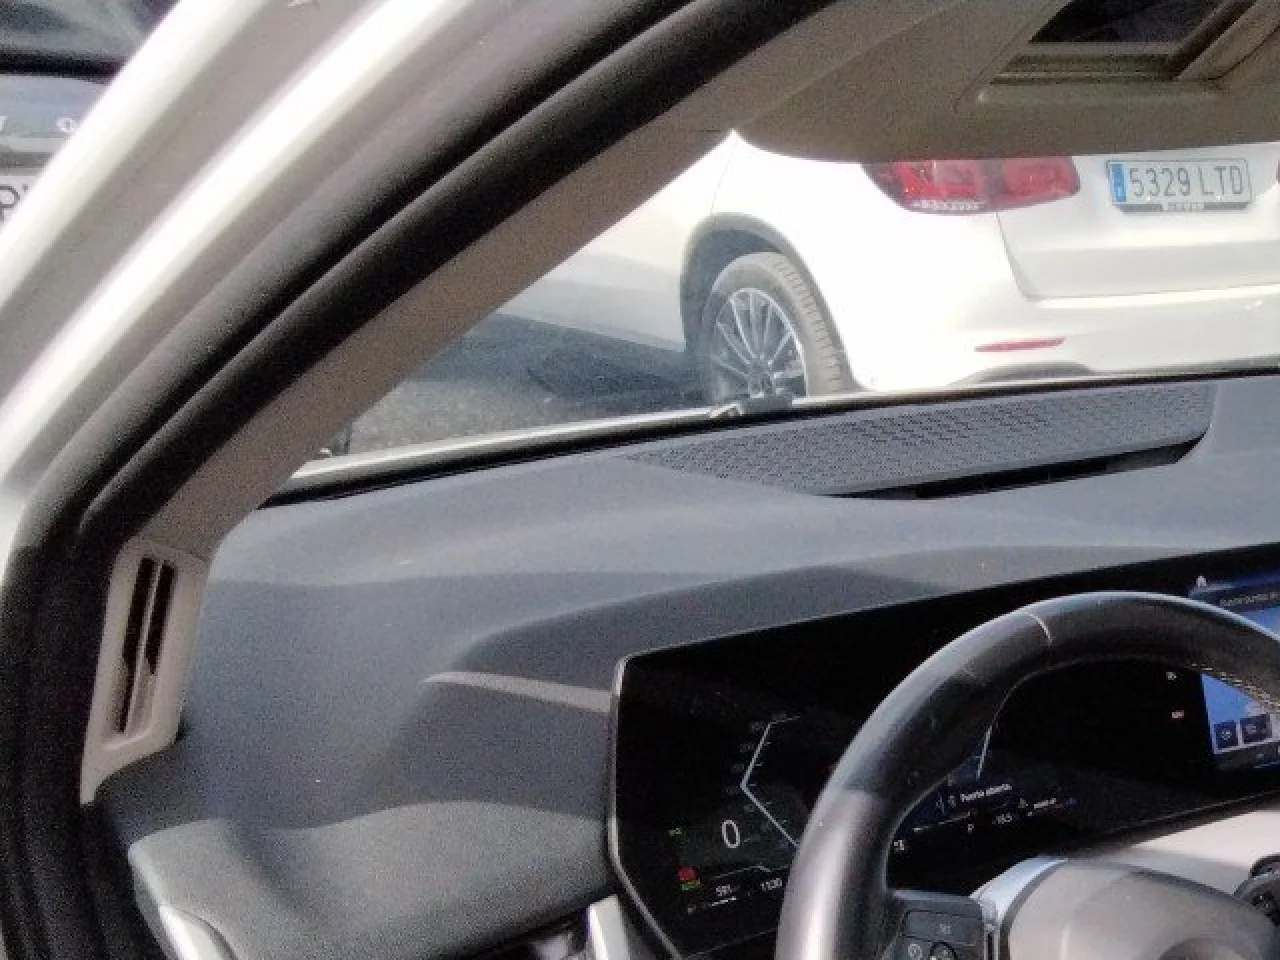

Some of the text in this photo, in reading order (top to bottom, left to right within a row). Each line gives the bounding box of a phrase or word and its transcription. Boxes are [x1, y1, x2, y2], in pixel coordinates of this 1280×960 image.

[1129, 165, 1244, 197] 5329 LTD
[720, 819, 741, 849] 0
